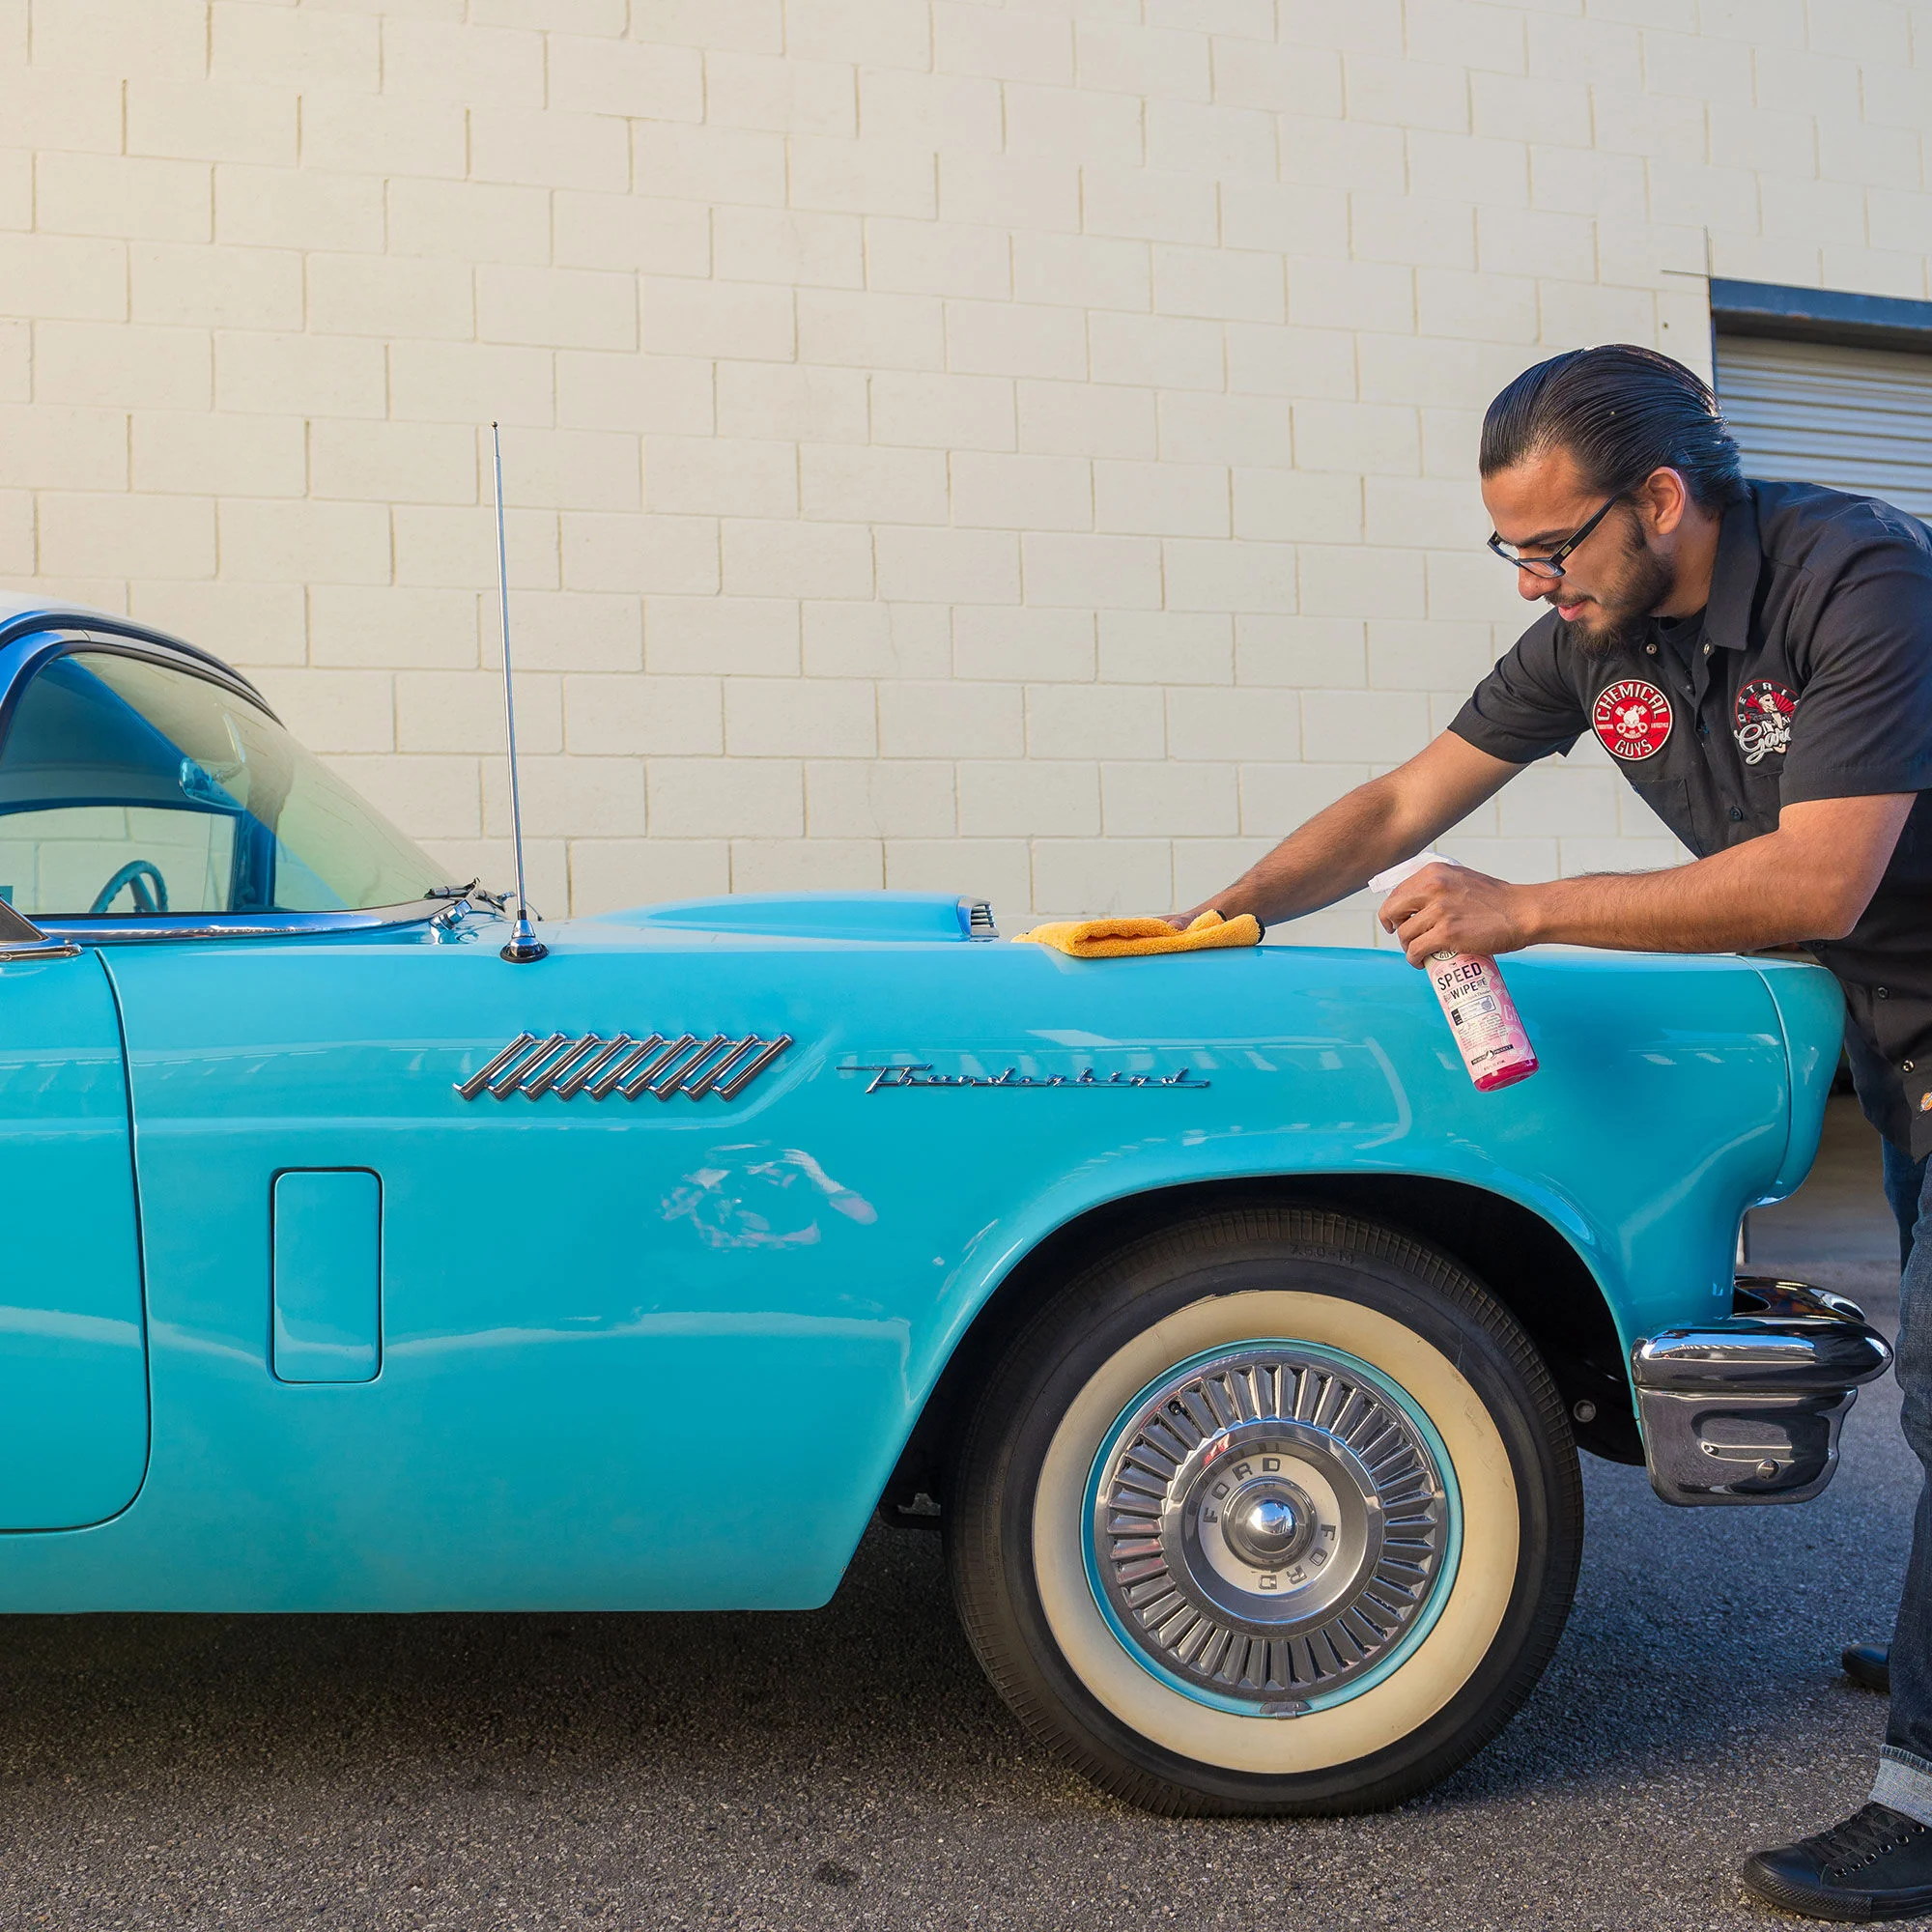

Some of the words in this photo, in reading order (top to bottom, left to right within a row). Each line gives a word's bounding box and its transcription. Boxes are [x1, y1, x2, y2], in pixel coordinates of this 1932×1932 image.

[1597, 683, 1667, 721] CHEMICAL
[1614, 739, 1653, 756] GUYS
[1437, 962, 1483, 991] SPEED
[1450, 980, 1479, 1000] WIPE
[836, 1064, 1210, 1094] Thunderbird
[1203, 1457, 1281, 1523] FORD
[1259, 1523, 1337, 1590] FORD
